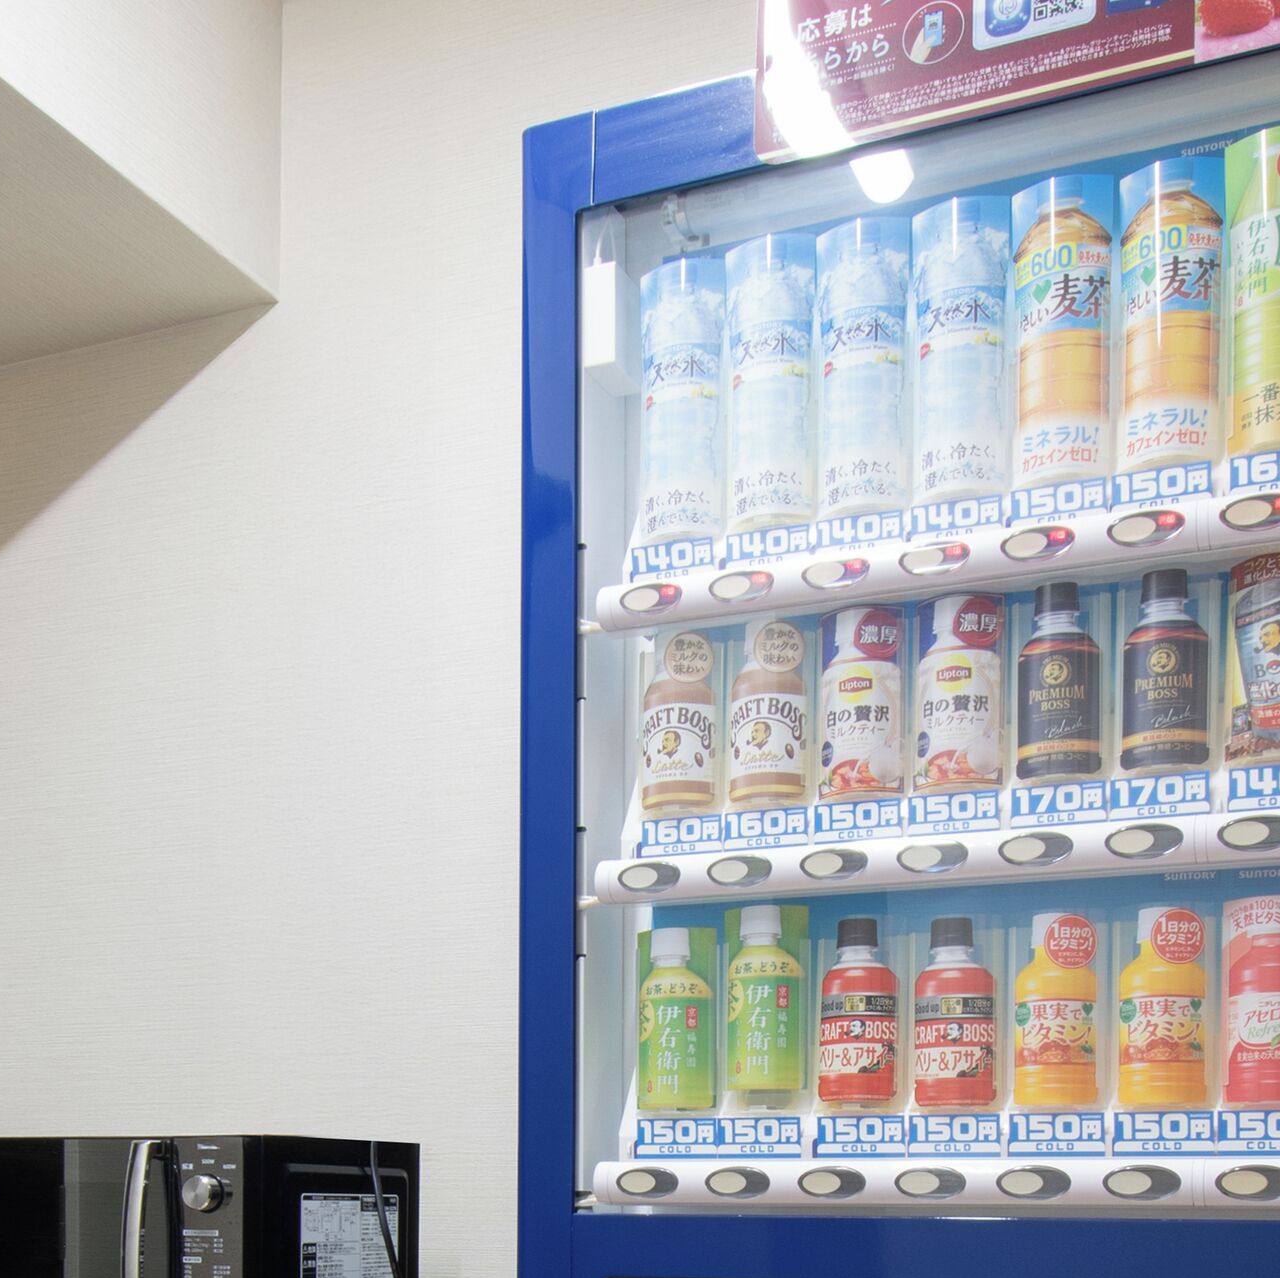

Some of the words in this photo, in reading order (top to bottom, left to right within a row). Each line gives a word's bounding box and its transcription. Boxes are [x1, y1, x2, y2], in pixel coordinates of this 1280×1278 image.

[1030, 244, 1073, 277] 600
[1051, 273, 1111, 321] 麦茶
[1127, 408, 1209, 437] ミネラル!
[1126, 431, 1207, 457] カフェインゼロ!
[1115, 468, 1209, 502] 150円
[631, 540, 712, 573] 140円
[959, 613, 998, 633] 濃厚
[939, 669, 969, 681] Lipton
[1134, 673, 1193, 694] PREMIUM
[923, 695, 990, 719] 白の贅沢
[1147, 688, 1179, 700] BOSS
[1115, 775, 1207, 807] 170円
[911, 792, 997, 823] 150円
[642, 817, 719, 846] 160円
[1156, 932, 1201, 946] ビタミン!
[1157, 918, 1200, 934] 1日分の
[745, 983, 773, 1076] 伊右衛門
[865, 1021, 897, 1040] BOSS
[640, 1119, 714, 1144] 150円
[820, 1118, 902, 1143] 150円
[1013, 1115, 1101, 1141] 150円
